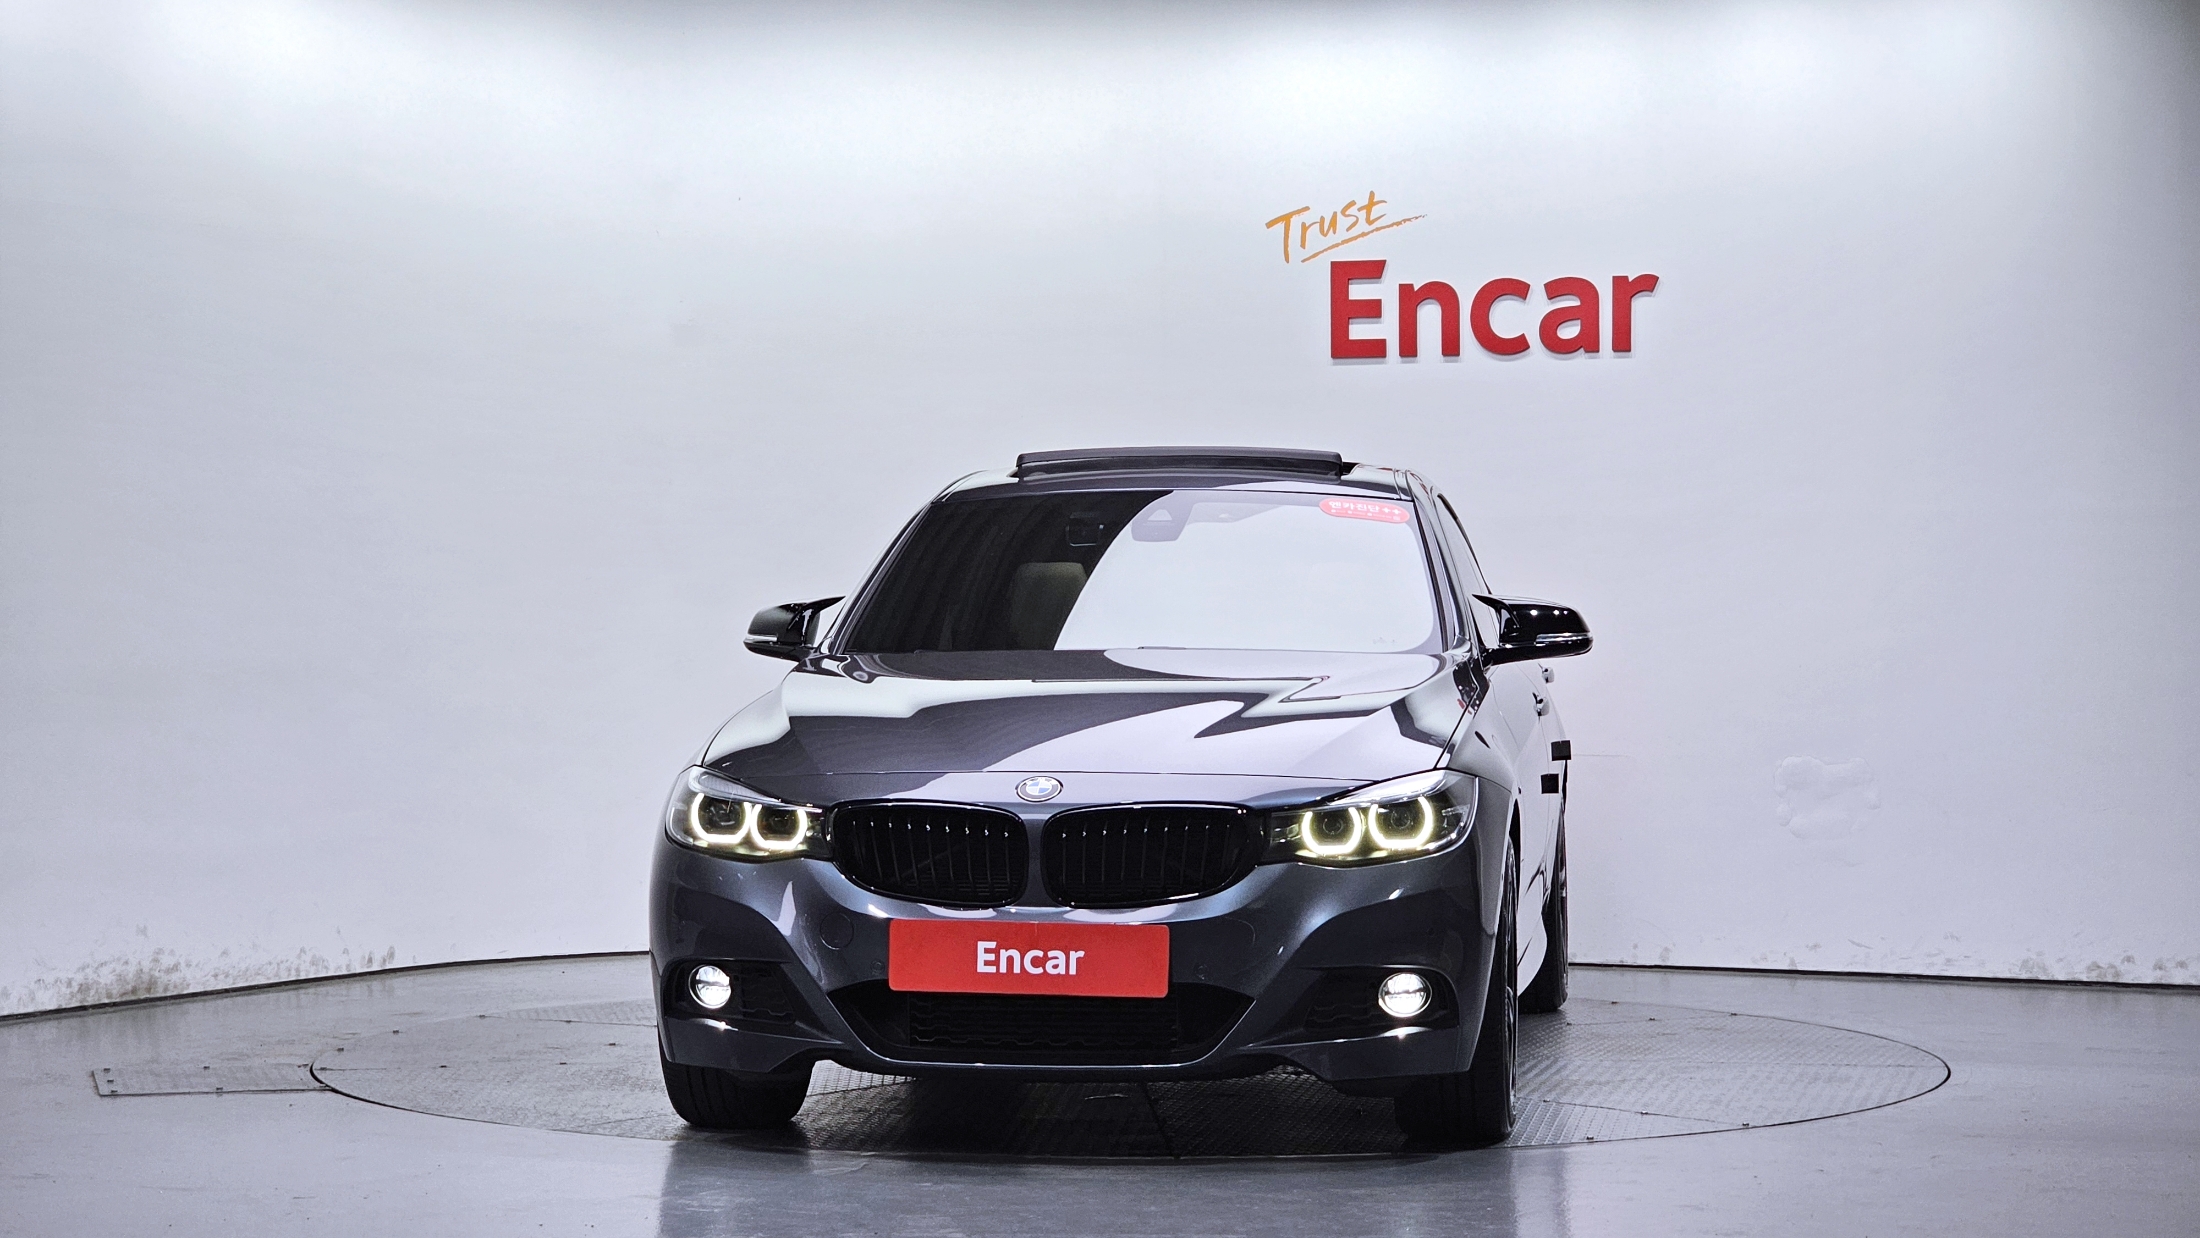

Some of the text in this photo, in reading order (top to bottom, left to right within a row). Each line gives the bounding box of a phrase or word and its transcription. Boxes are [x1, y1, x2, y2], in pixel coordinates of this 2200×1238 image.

[1266, 190, 1388, 263] Trust
[1330, 259, 1659, 358] Encar
[976, 940, 1085, 975] Encar
